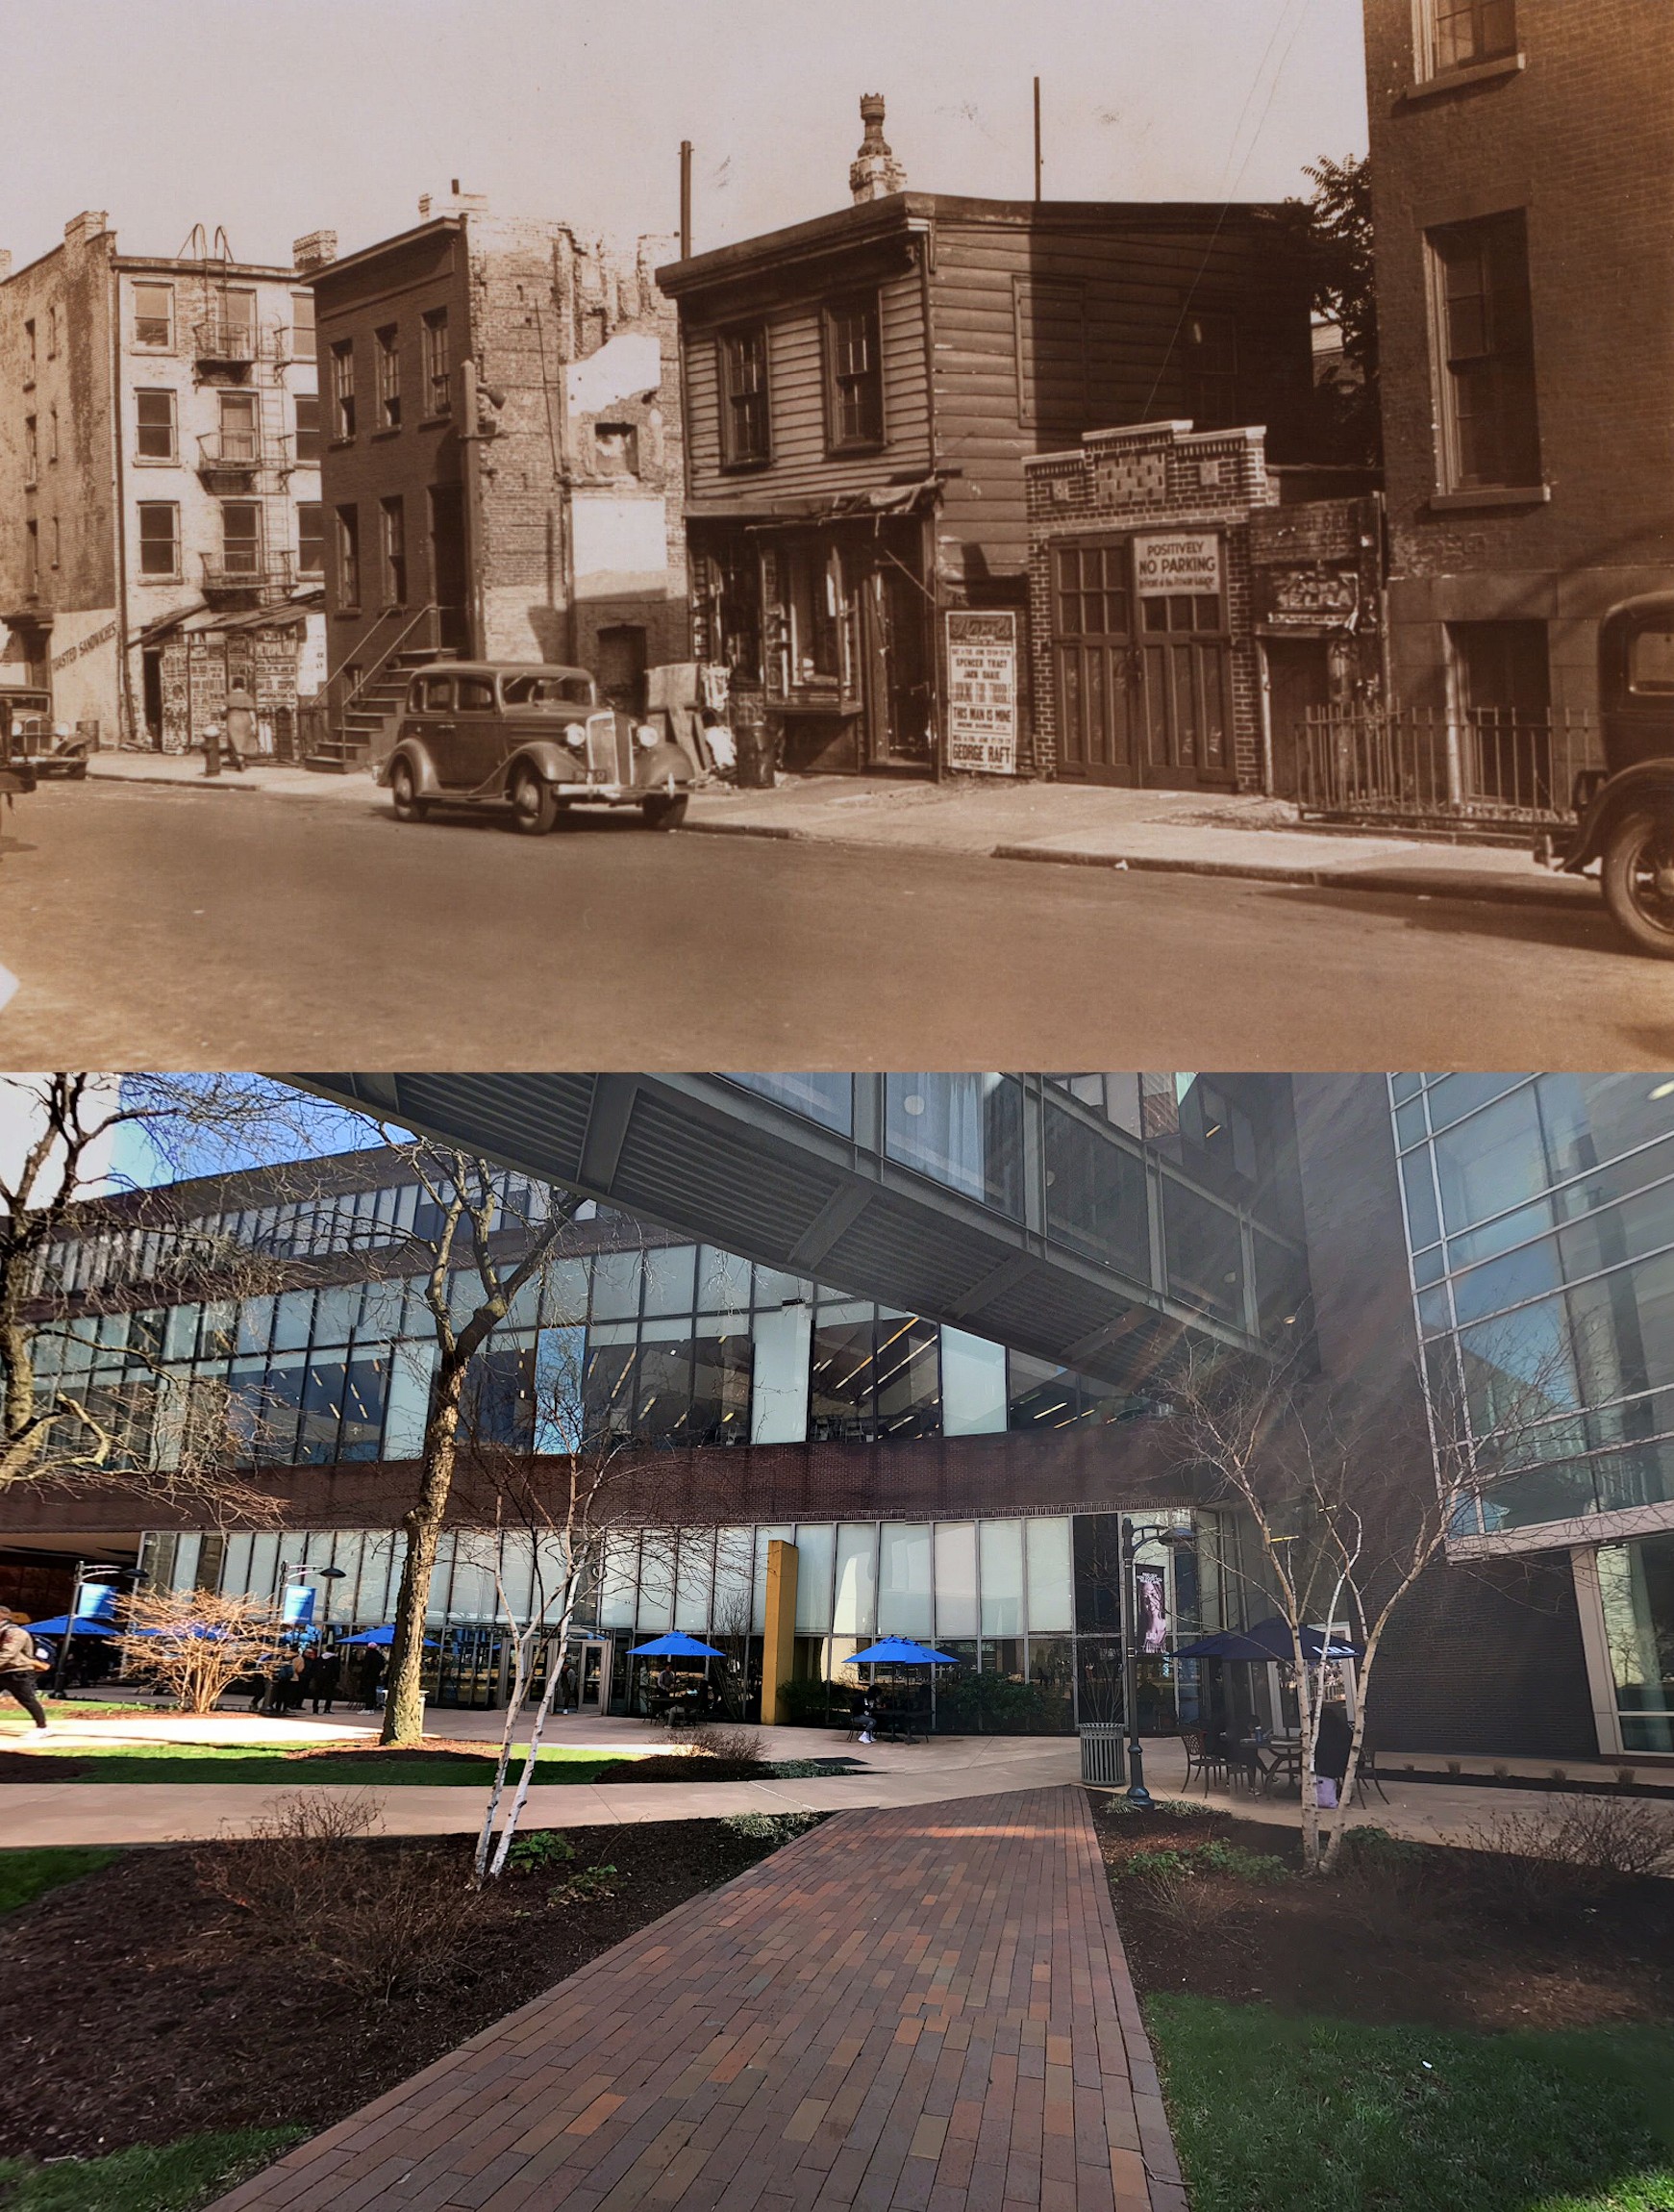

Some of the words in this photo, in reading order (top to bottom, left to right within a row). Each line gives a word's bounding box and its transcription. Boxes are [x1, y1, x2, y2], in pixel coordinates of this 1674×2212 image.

[1147, 541, 1204, 557] POSITIVELY
[1138, 560, 1157, 576] NO
[1162, 556, 1215, 574] PARKING
[954, 706, 967, 719] THIS
[969, 707, 985, 720] MAN
[987, 709, 993, 721] IS
[953, 743, 984, 762] GEORGE
[987, 745, 1011, 764] RAFT
